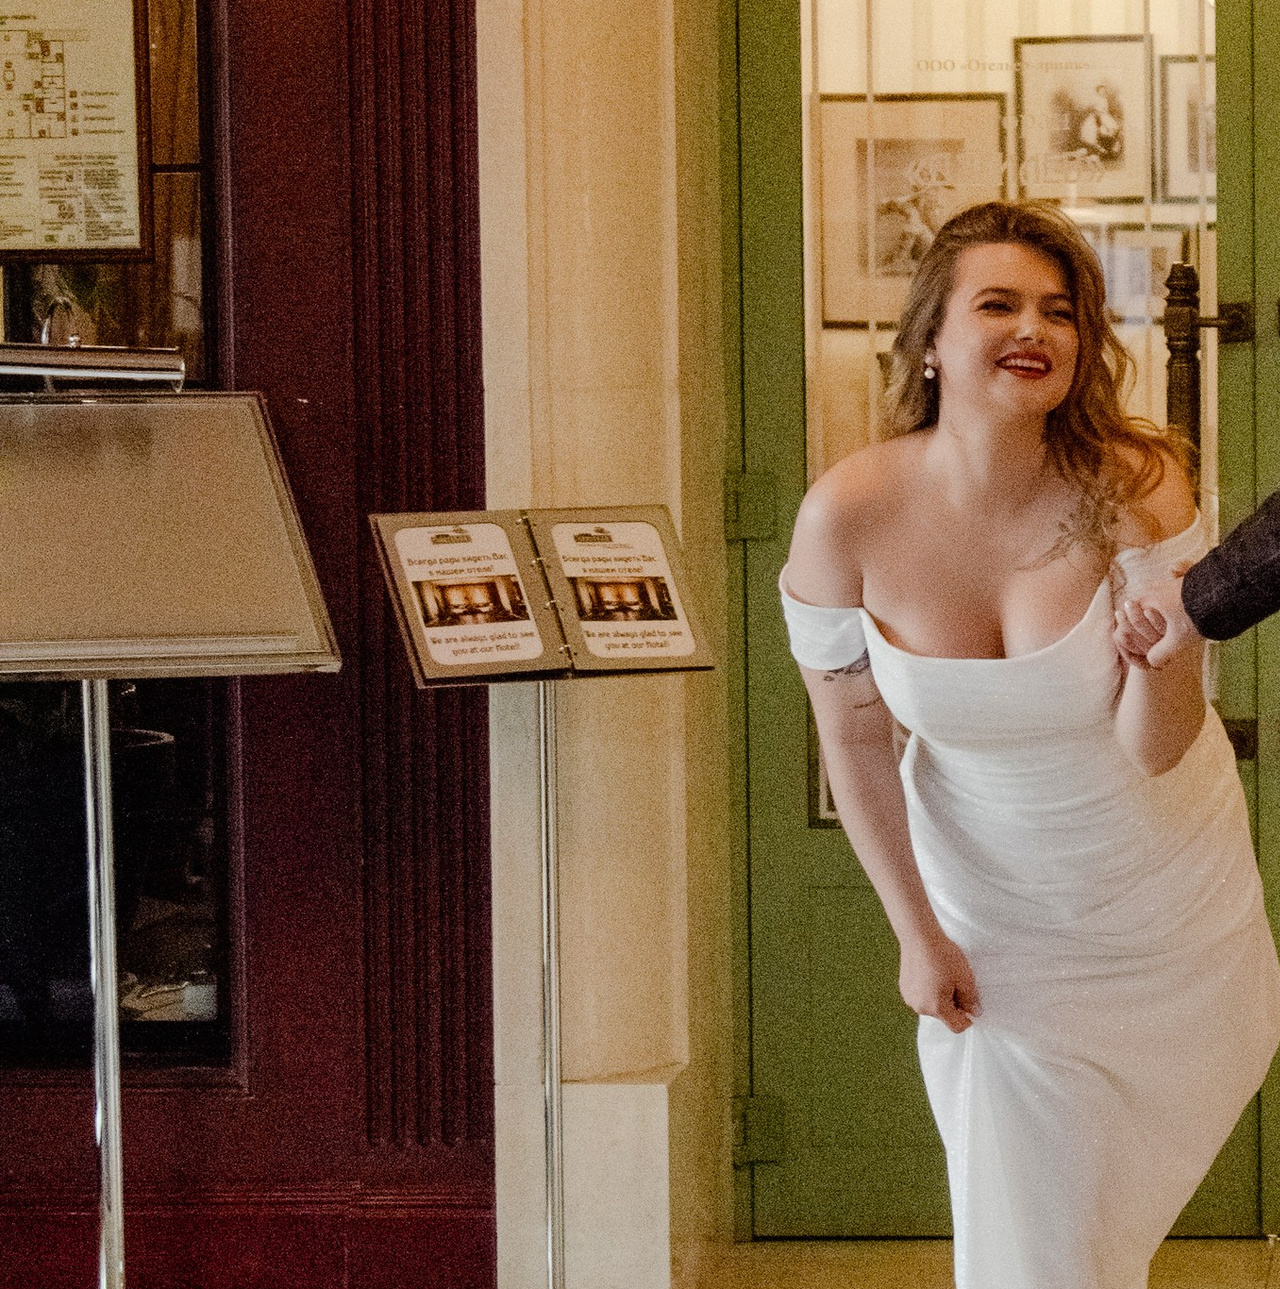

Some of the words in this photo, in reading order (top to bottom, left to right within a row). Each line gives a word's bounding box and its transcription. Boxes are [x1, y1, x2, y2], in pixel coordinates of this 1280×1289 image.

[430, 636, 442, 644] We
[444, 636, 458, 644] are
[460, 634, 488, 643] always
[489, 632, 507, 642] glad
[612, 630, 639, 639] always
[640, 630, 657, 639] glad
[605, 642, 620, 650] you
[452, 648, 468, 657] you
